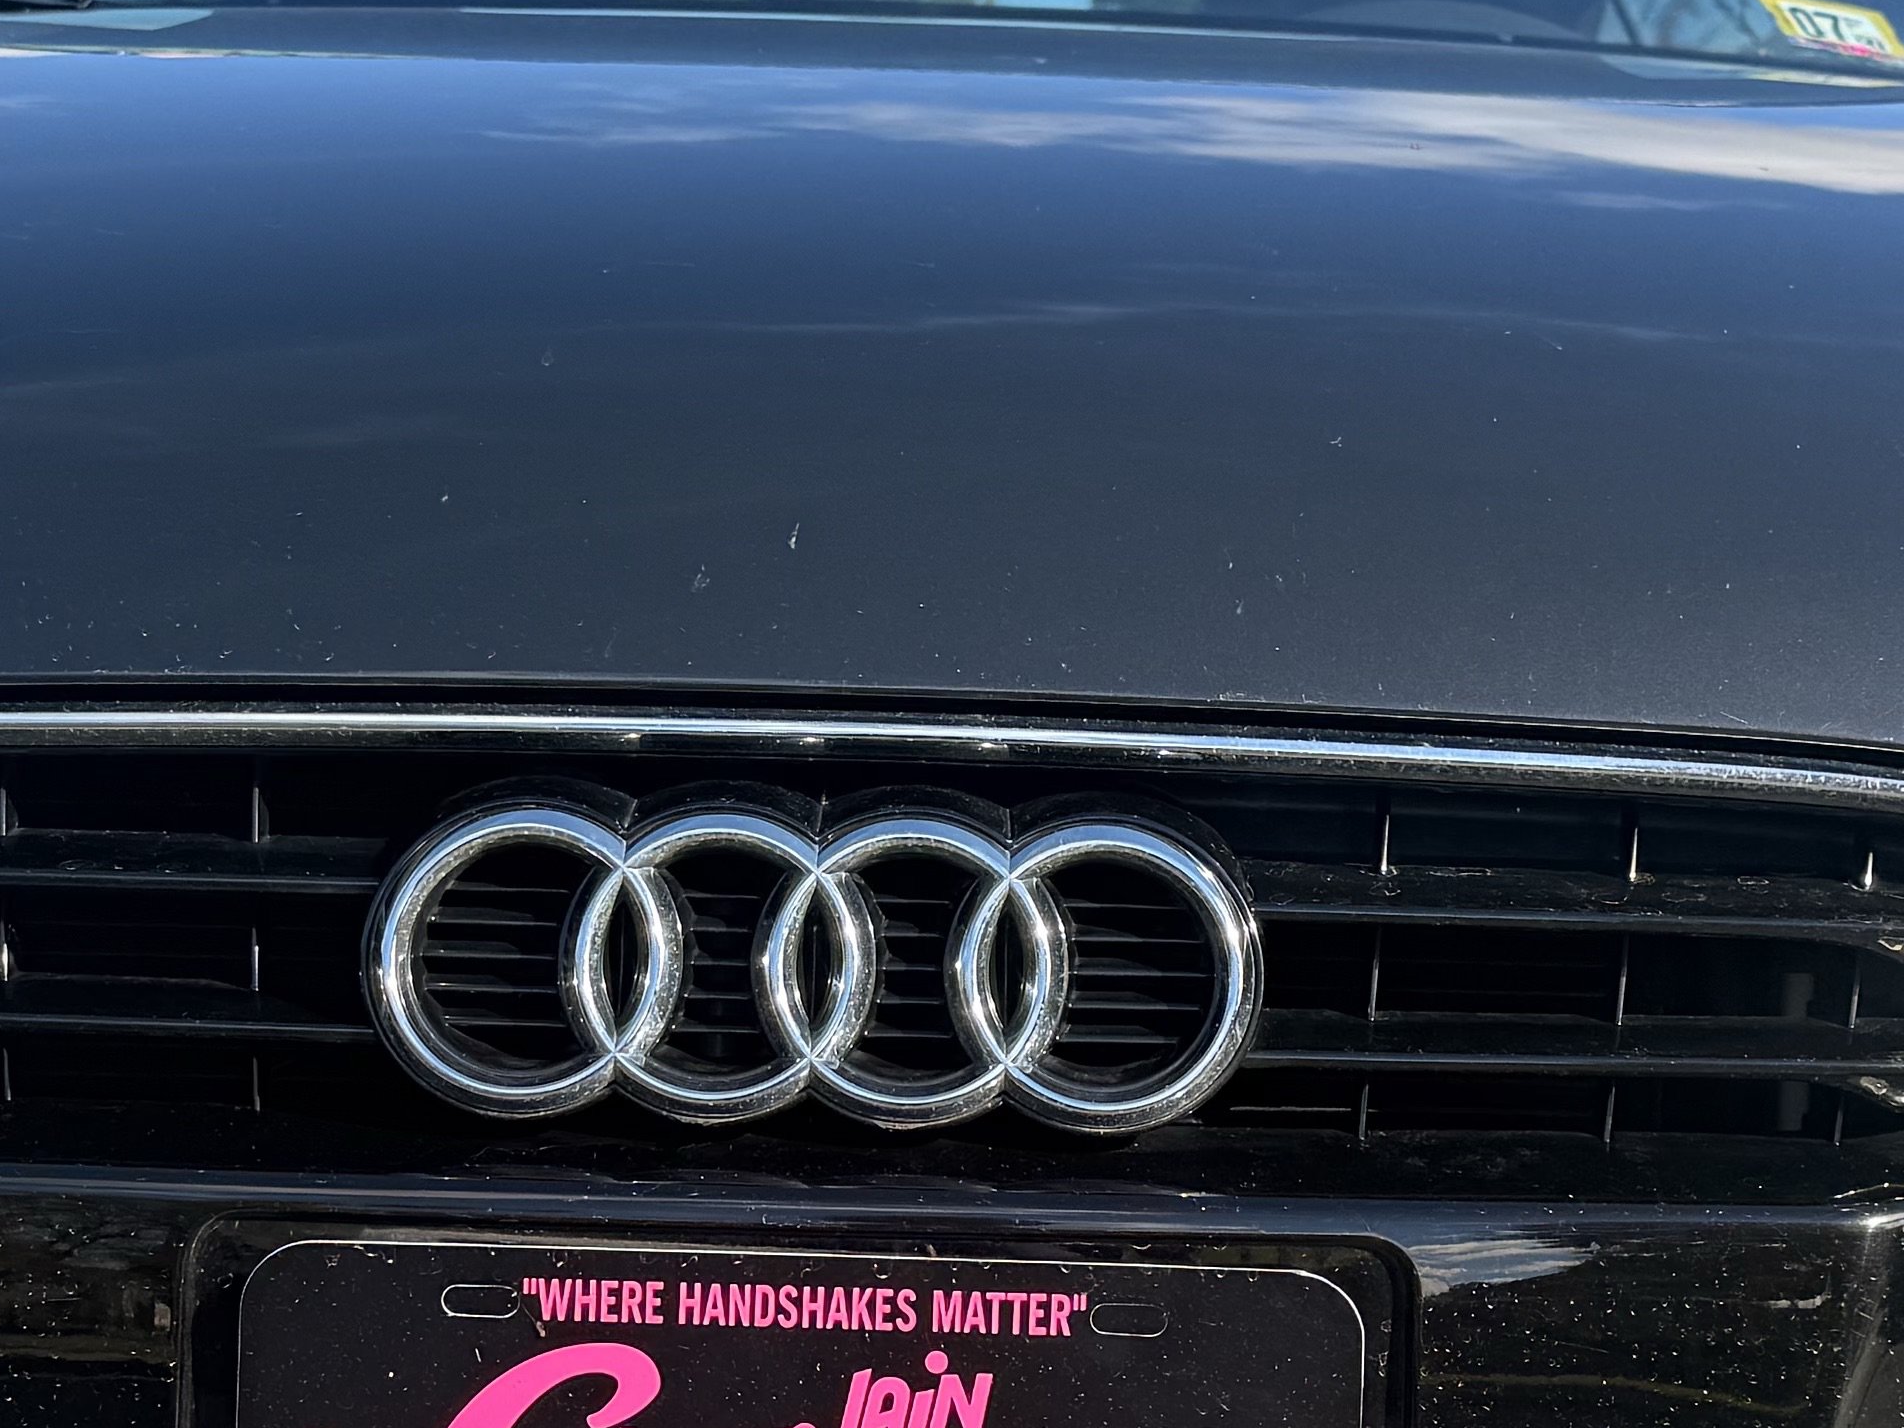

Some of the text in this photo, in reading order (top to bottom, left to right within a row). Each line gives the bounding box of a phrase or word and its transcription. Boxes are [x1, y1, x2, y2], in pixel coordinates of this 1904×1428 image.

[1788, 6, 1846, 42] 07
[521, 1276, 1088, 1337] "WHERE HANDSHAKES MATTER"
